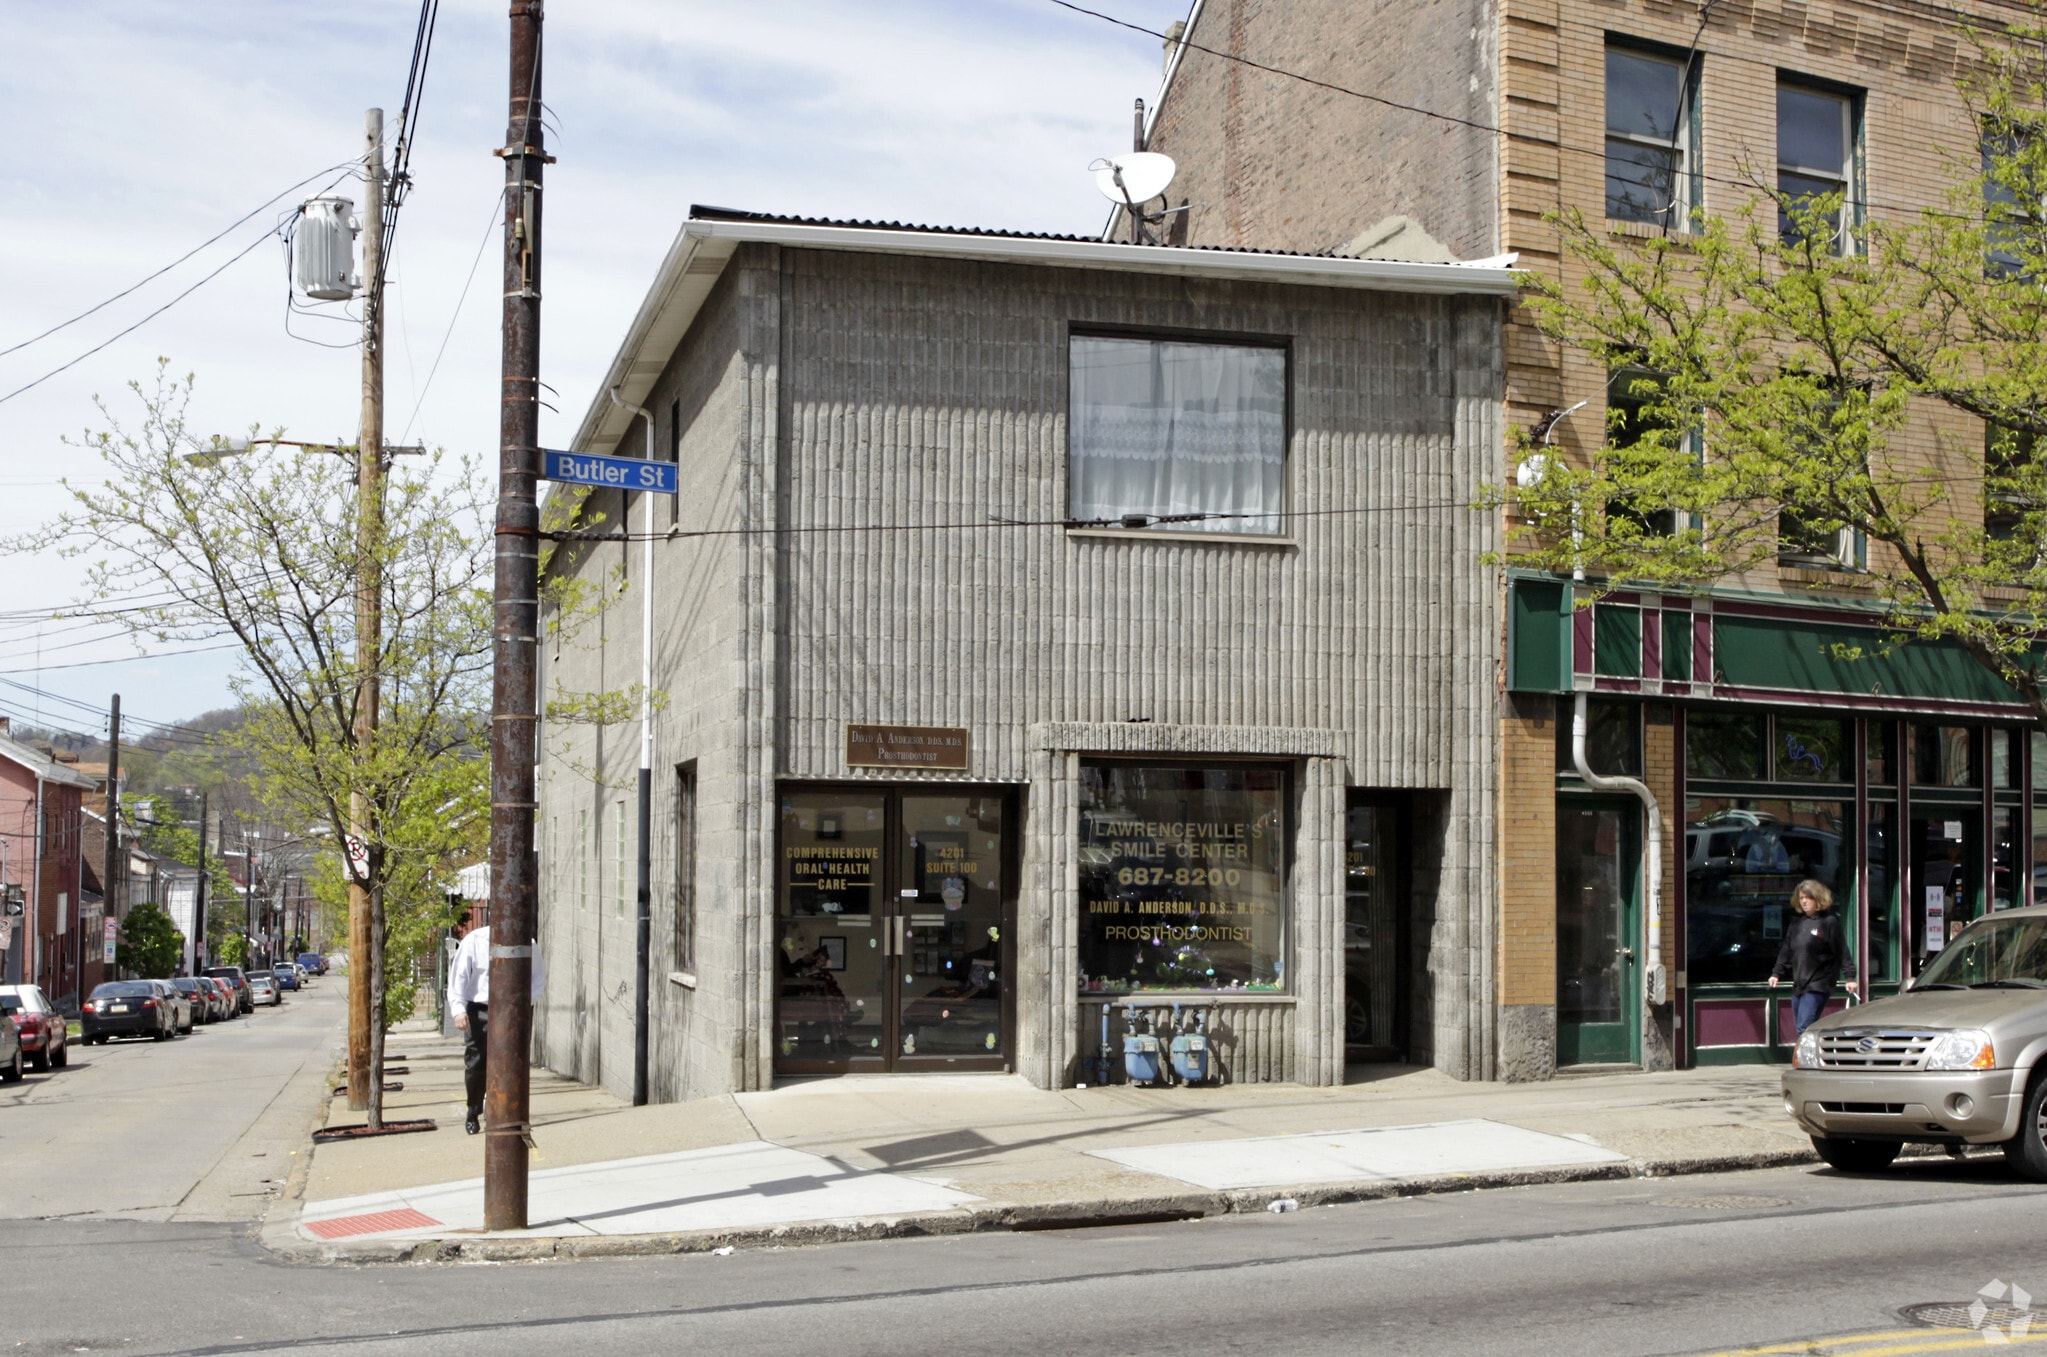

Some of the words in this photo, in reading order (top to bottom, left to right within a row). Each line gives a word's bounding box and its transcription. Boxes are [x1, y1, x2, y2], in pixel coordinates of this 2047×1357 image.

[559, 456, 629, 483] Butler
[639, 465, 665, 487] St
[1095, 822, 1263, 839] LAWRENCEVILLE'S
[786, 846, 879, 859] COMPREHENSIVE
[939, 847, 964, 859] 4201
[1111, 841, 1167, 858] SMILE
[1176, 843, 1249, 859] CENTER
[795, 863, 824, 875] ORAL
[829, 863, 870, 875] HEALTH
[926, 862, 955, 874] SUITE
[960, 862, 977, 874] 100
[1117, 867, 1241, 886] 687-8200
[818, 879, 847, 891] CARE
[1089, 901, 1120, 914] DAVID
[1123, 902, 1134, 914] A.
[1105, 926, 1252, 941] PROSTHODONTIST
